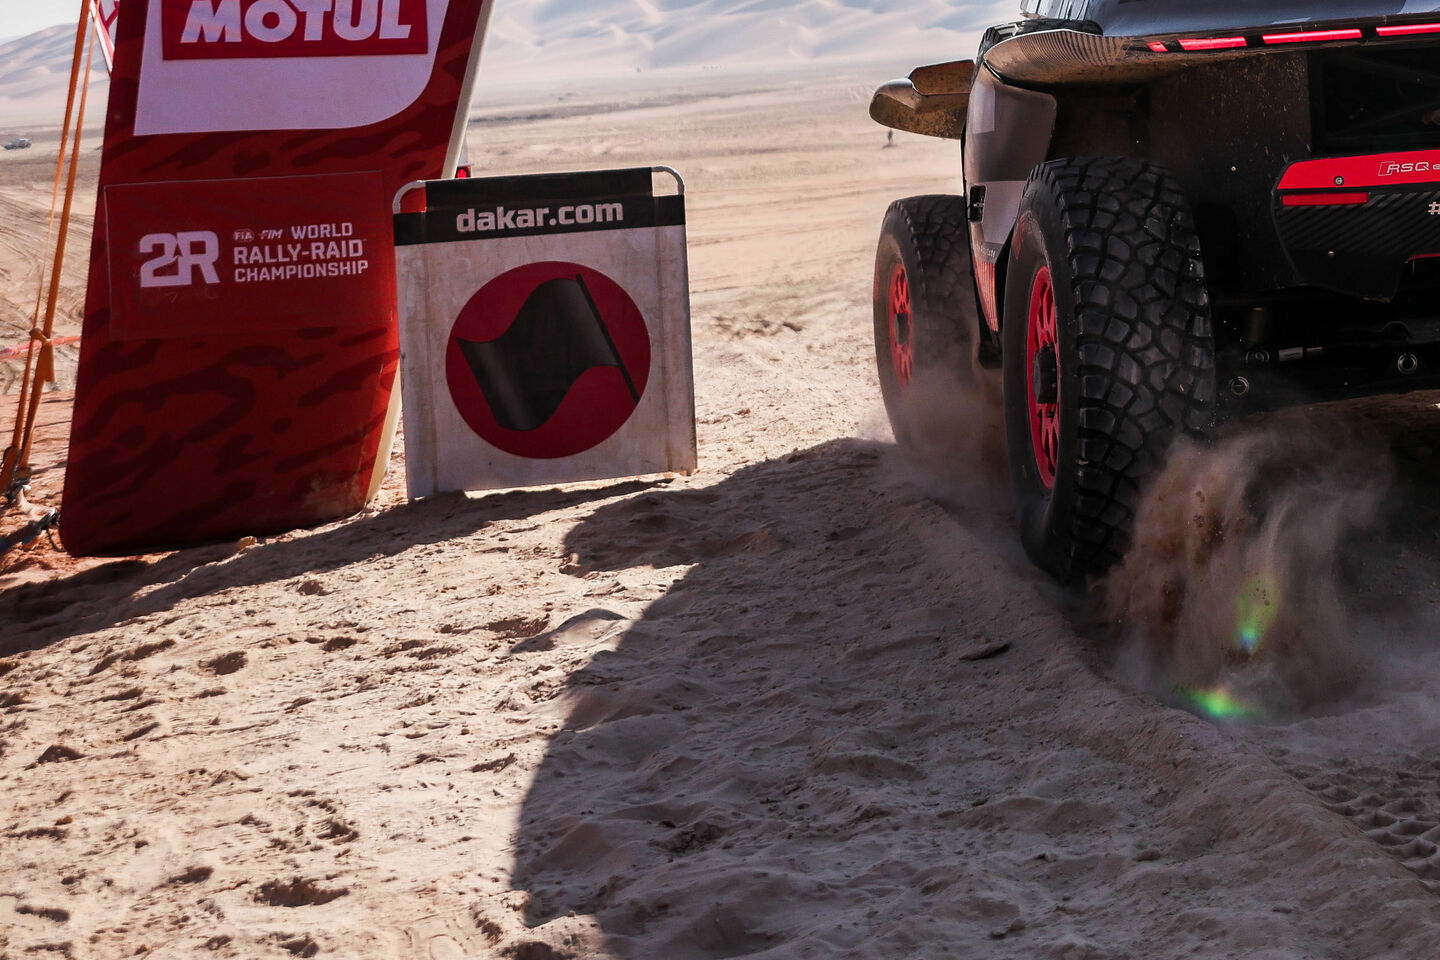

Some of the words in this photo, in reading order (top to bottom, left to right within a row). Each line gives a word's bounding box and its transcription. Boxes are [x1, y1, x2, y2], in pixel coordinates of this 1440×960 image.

[456, 202, 624, 233] dakar.com
[291, 222, 353, 240] WORLD
[233, 239, 363, 265] RALLY-RAID
[234, 260, 368, 283] CHAMPIONSHIP
